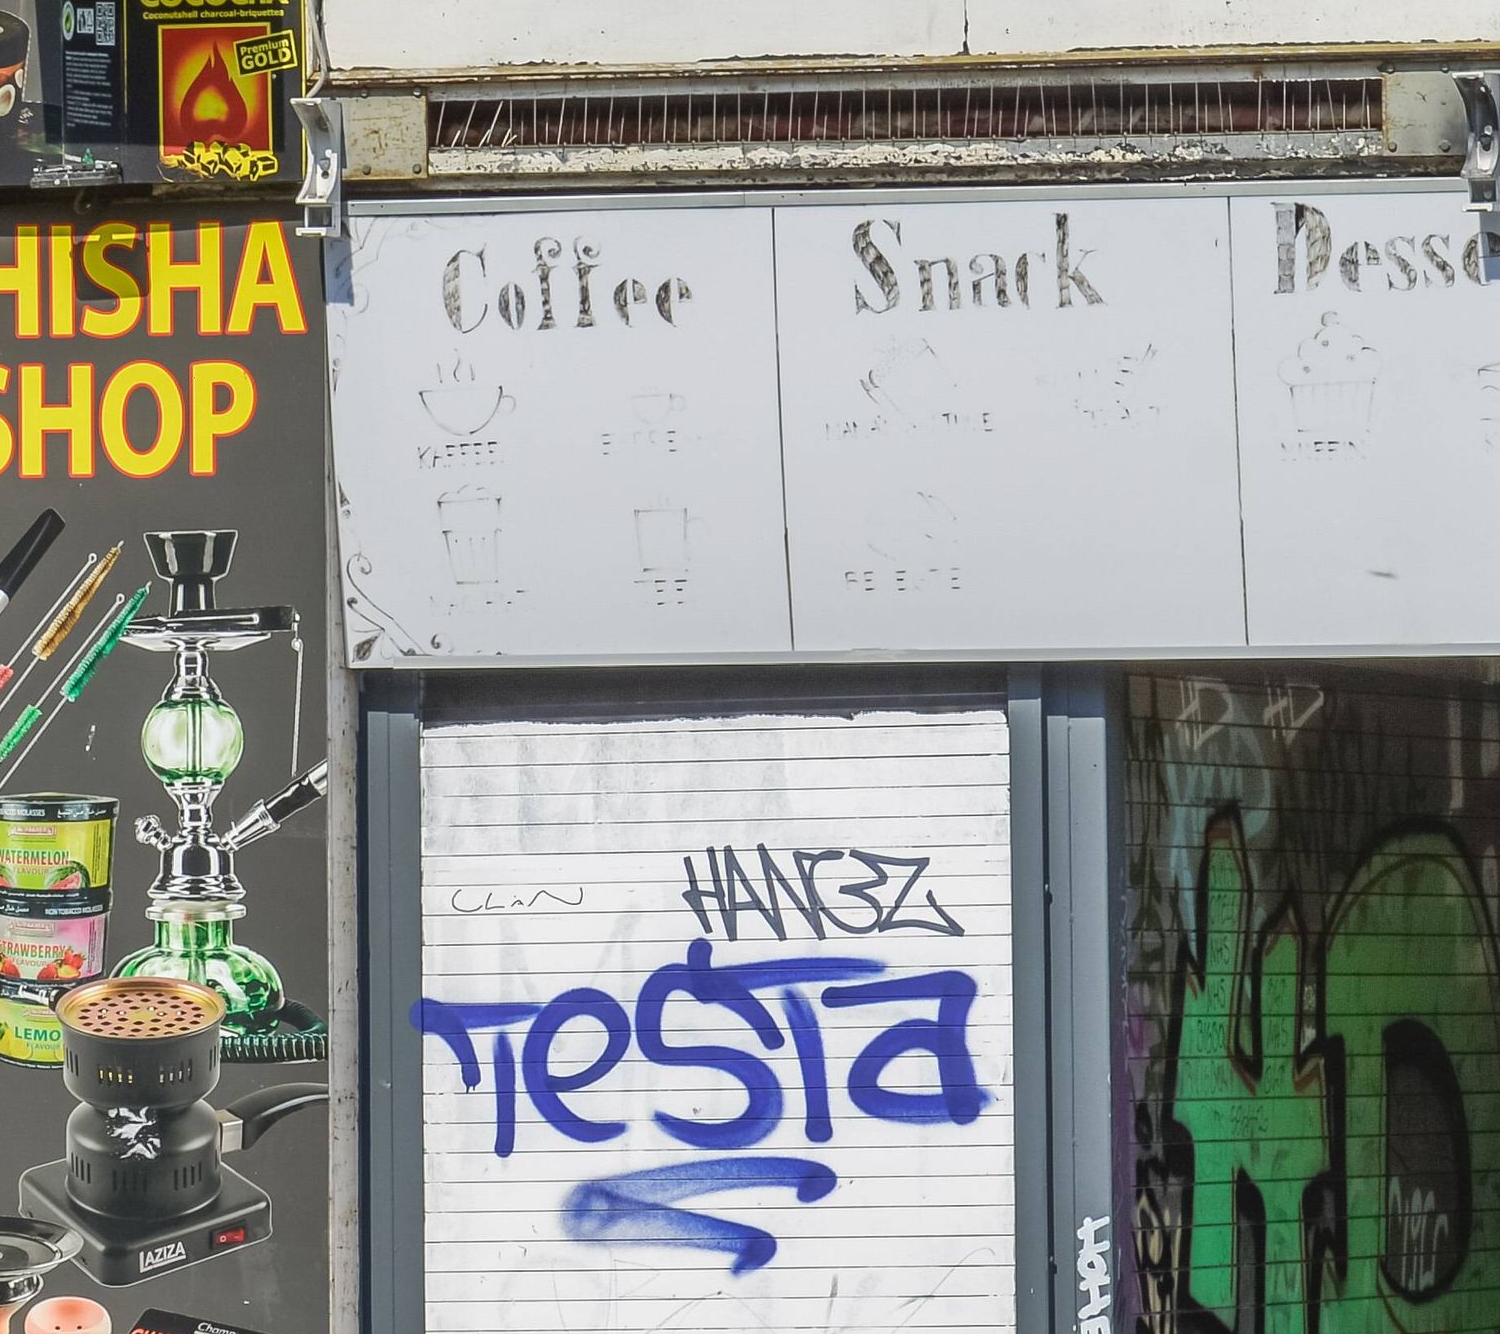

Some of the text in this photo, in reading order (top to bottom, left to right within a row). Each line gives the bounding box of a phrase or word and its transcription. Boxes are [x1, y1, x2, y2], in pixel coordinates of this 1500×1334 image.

[142, 8, 285, 21] Coconutshell charcoal-briquettes
[240, 38, 290, 56] Premium
[242, 48, 291, 71] GOLD
[854, 211, 1106, 316] Snack
[442, 235, 695, 336] Coffee
[139, 1241, 187, 1272] LAZIZA
